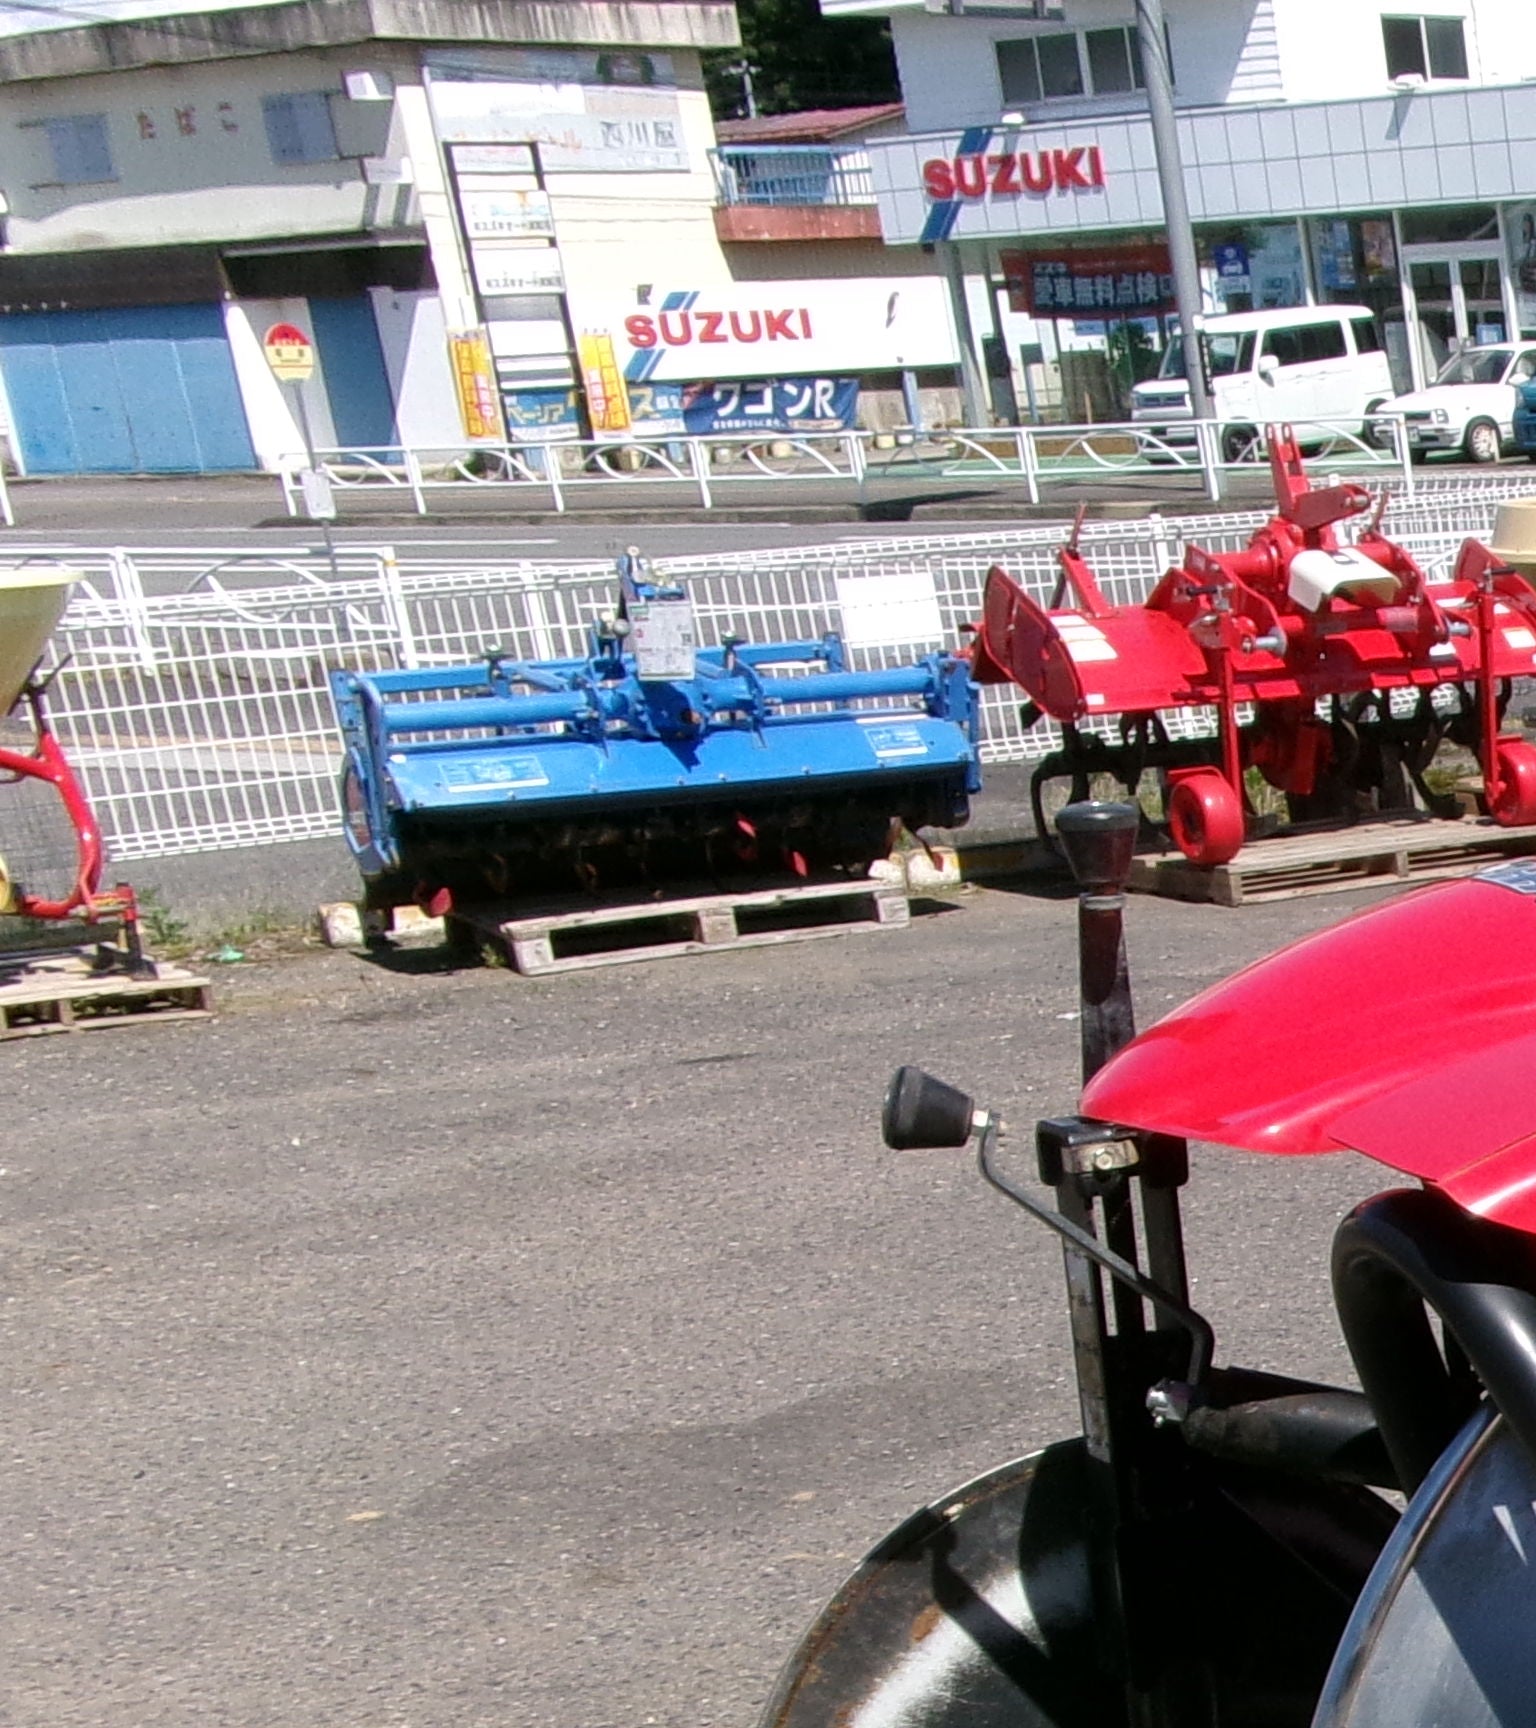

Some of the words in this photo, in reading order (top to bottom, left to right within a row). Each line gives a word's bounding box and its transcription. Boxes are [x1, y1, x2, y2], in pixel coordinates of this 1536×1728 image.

[923, 147, 1105, 198] SUZUKI
[624, 308, 812, 348] SUZUKI
[712, 379, 836, 418] ワゴンR
